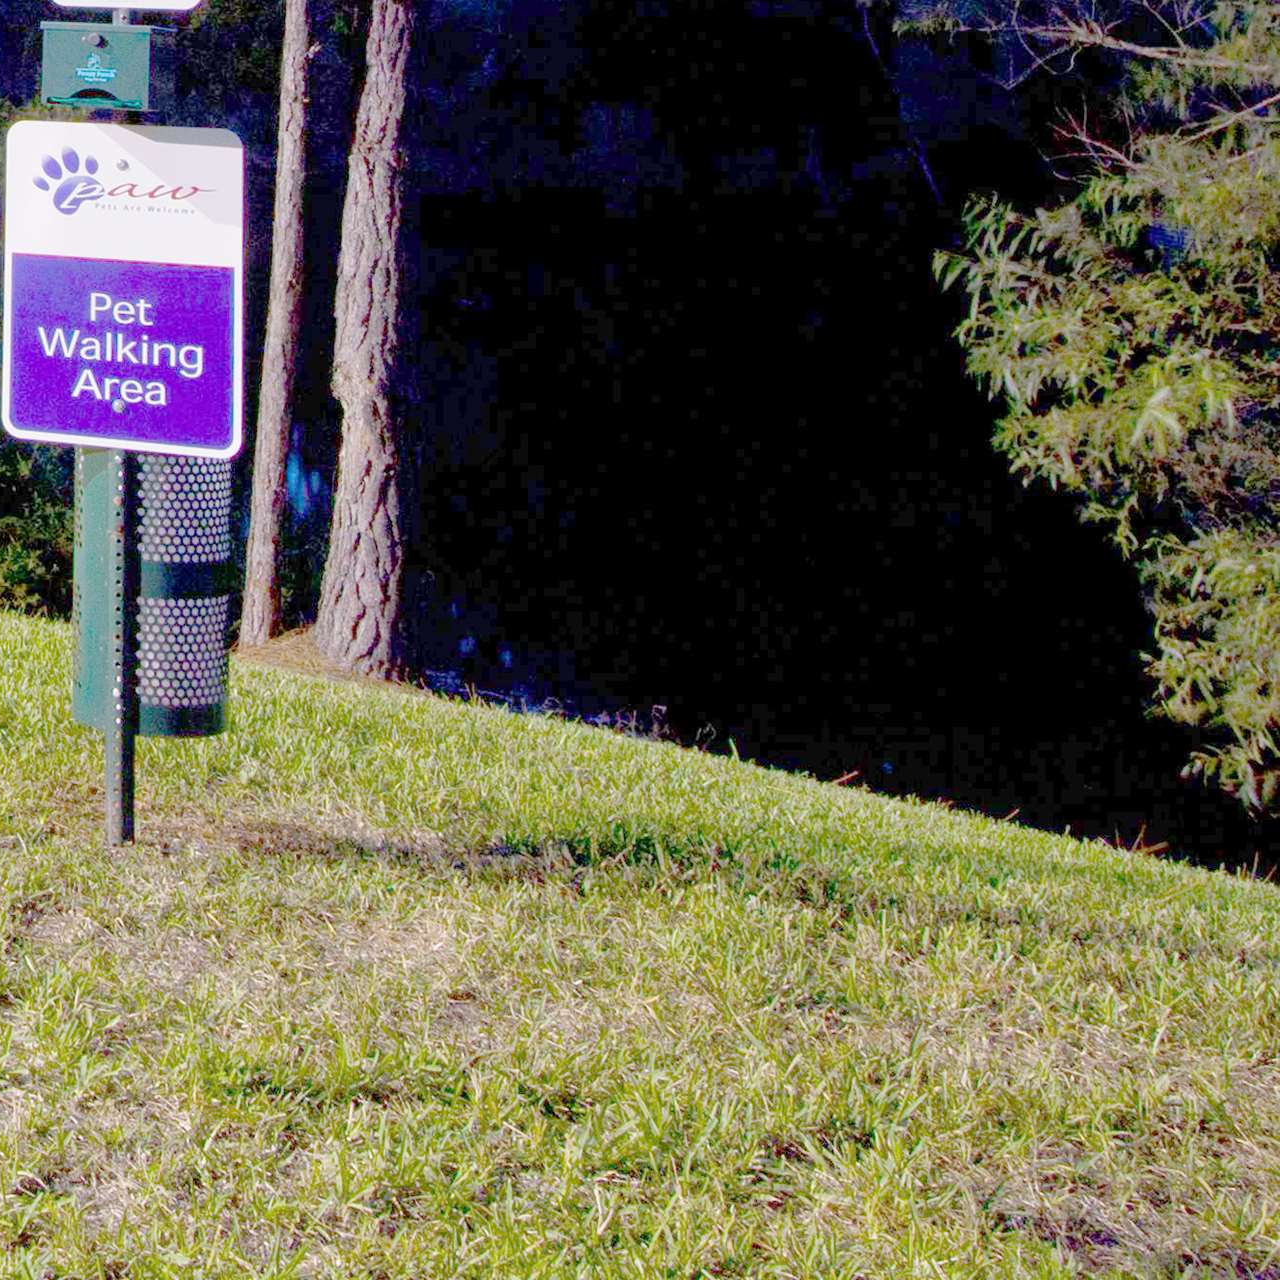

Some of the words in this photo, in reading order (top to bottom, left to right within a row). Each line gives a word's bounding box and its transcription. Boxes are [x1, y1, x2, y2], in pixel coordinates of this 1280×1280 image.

[95, 203, 118, 211] Pets
[147, 205, 196, 215] Welcome
[90, 292, 154, 327] Pet
[38, 326, 204, 379] Walking
[71, 369, 167, 407] Area
